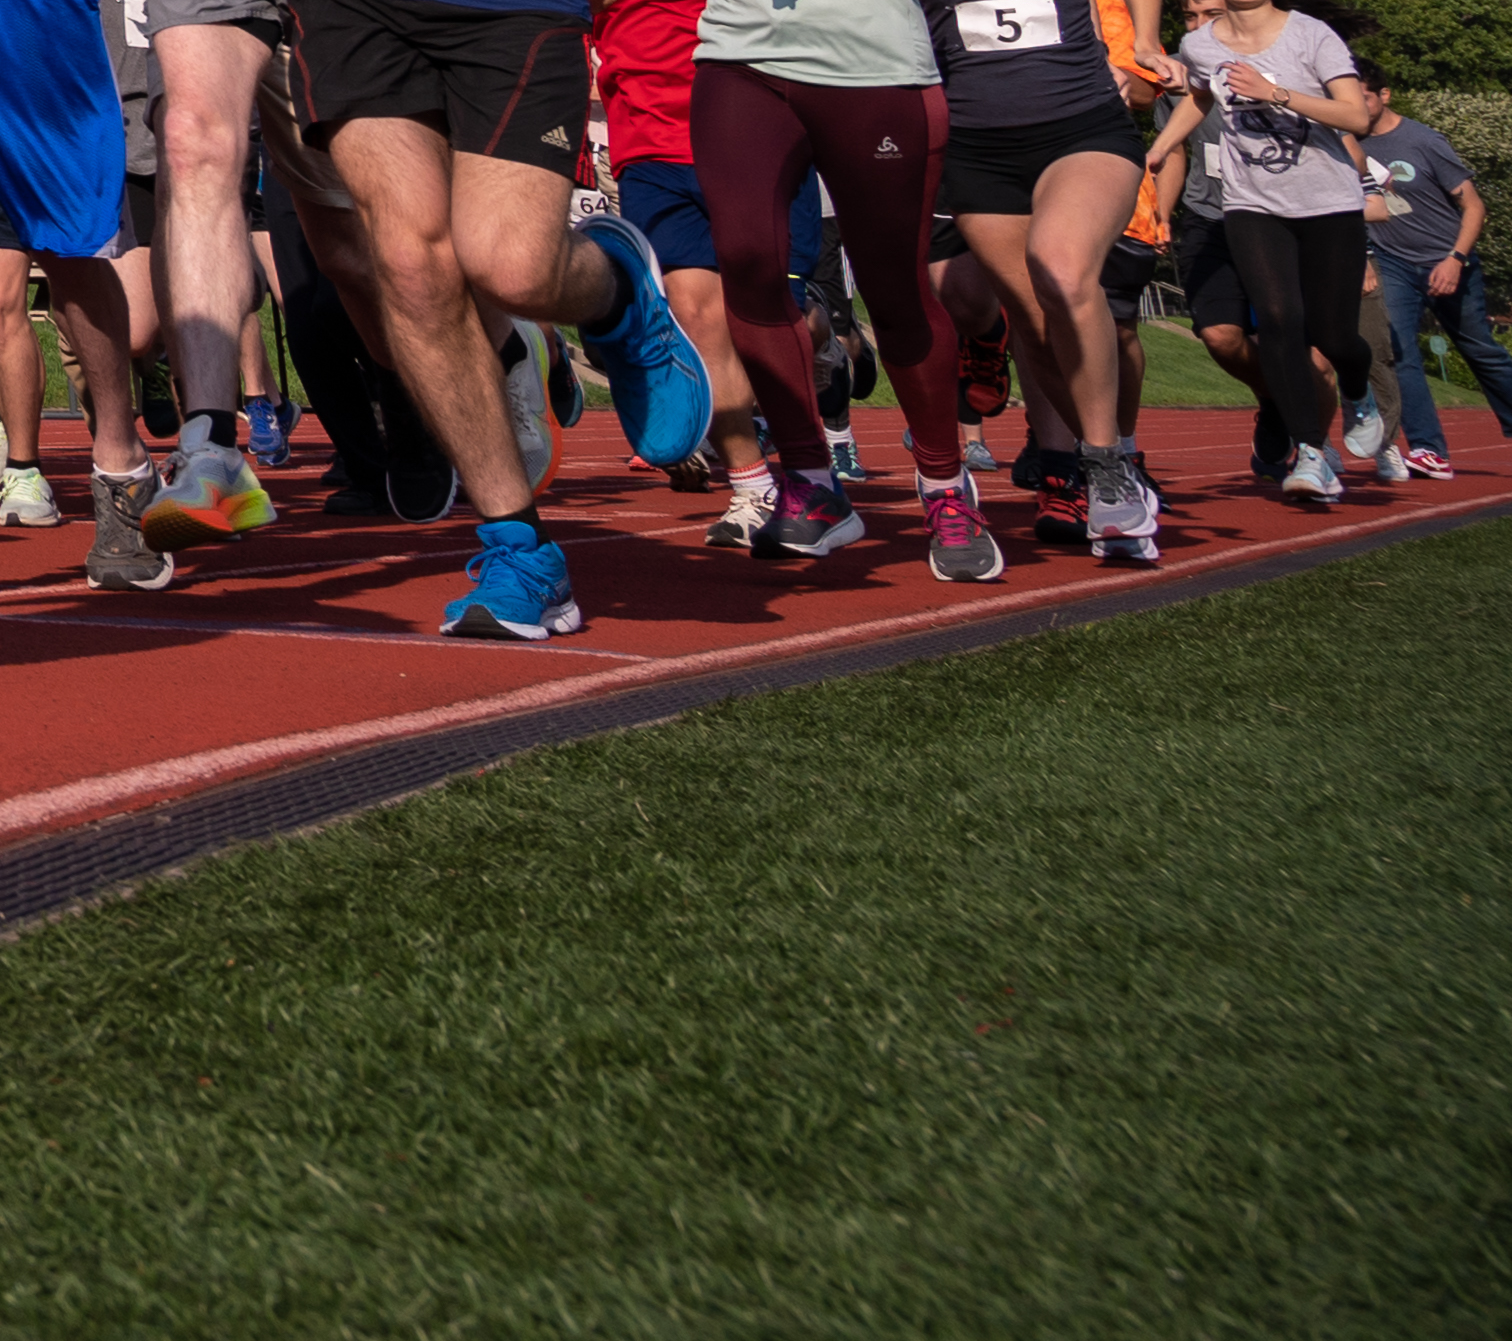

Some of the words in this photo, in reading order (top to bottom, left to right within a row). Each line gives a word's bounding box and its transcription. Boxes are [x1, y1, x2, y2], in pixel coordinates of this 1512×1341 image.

[994, 8, 1022, 44] 5
[540, 134, 571, 151] adidas
[579, 196, 610, 215] 64
